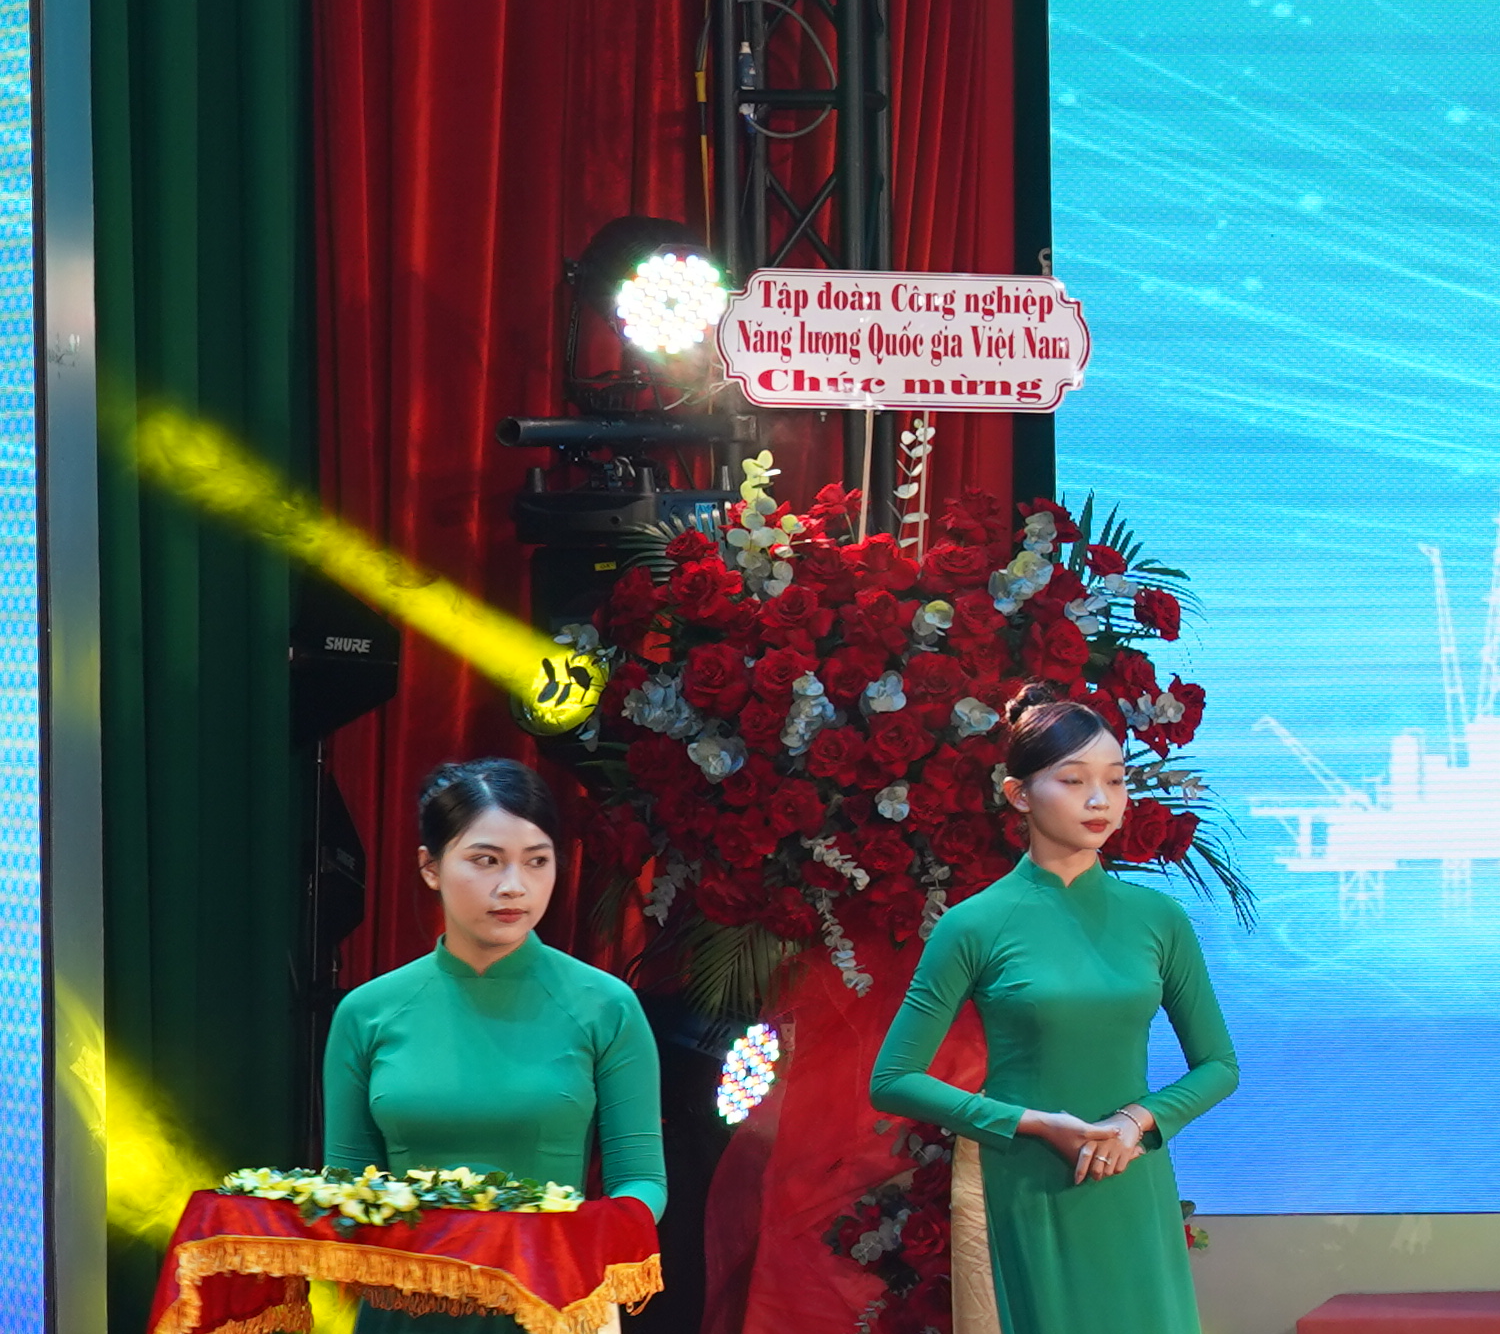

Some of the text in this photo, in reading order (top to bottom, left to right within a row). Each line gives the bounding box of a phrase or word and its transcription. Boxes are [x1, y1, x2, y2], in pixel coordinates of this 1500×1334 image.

[758, 280, 1053, 323] Tập đoàn Công nghiệp
[737, 320, 1070, 367] Năng lượng Quốc gia Việt Nam
[757, 368, 1043, 404] Chúc mừng
[324, 636, 373, 654] SHURE
